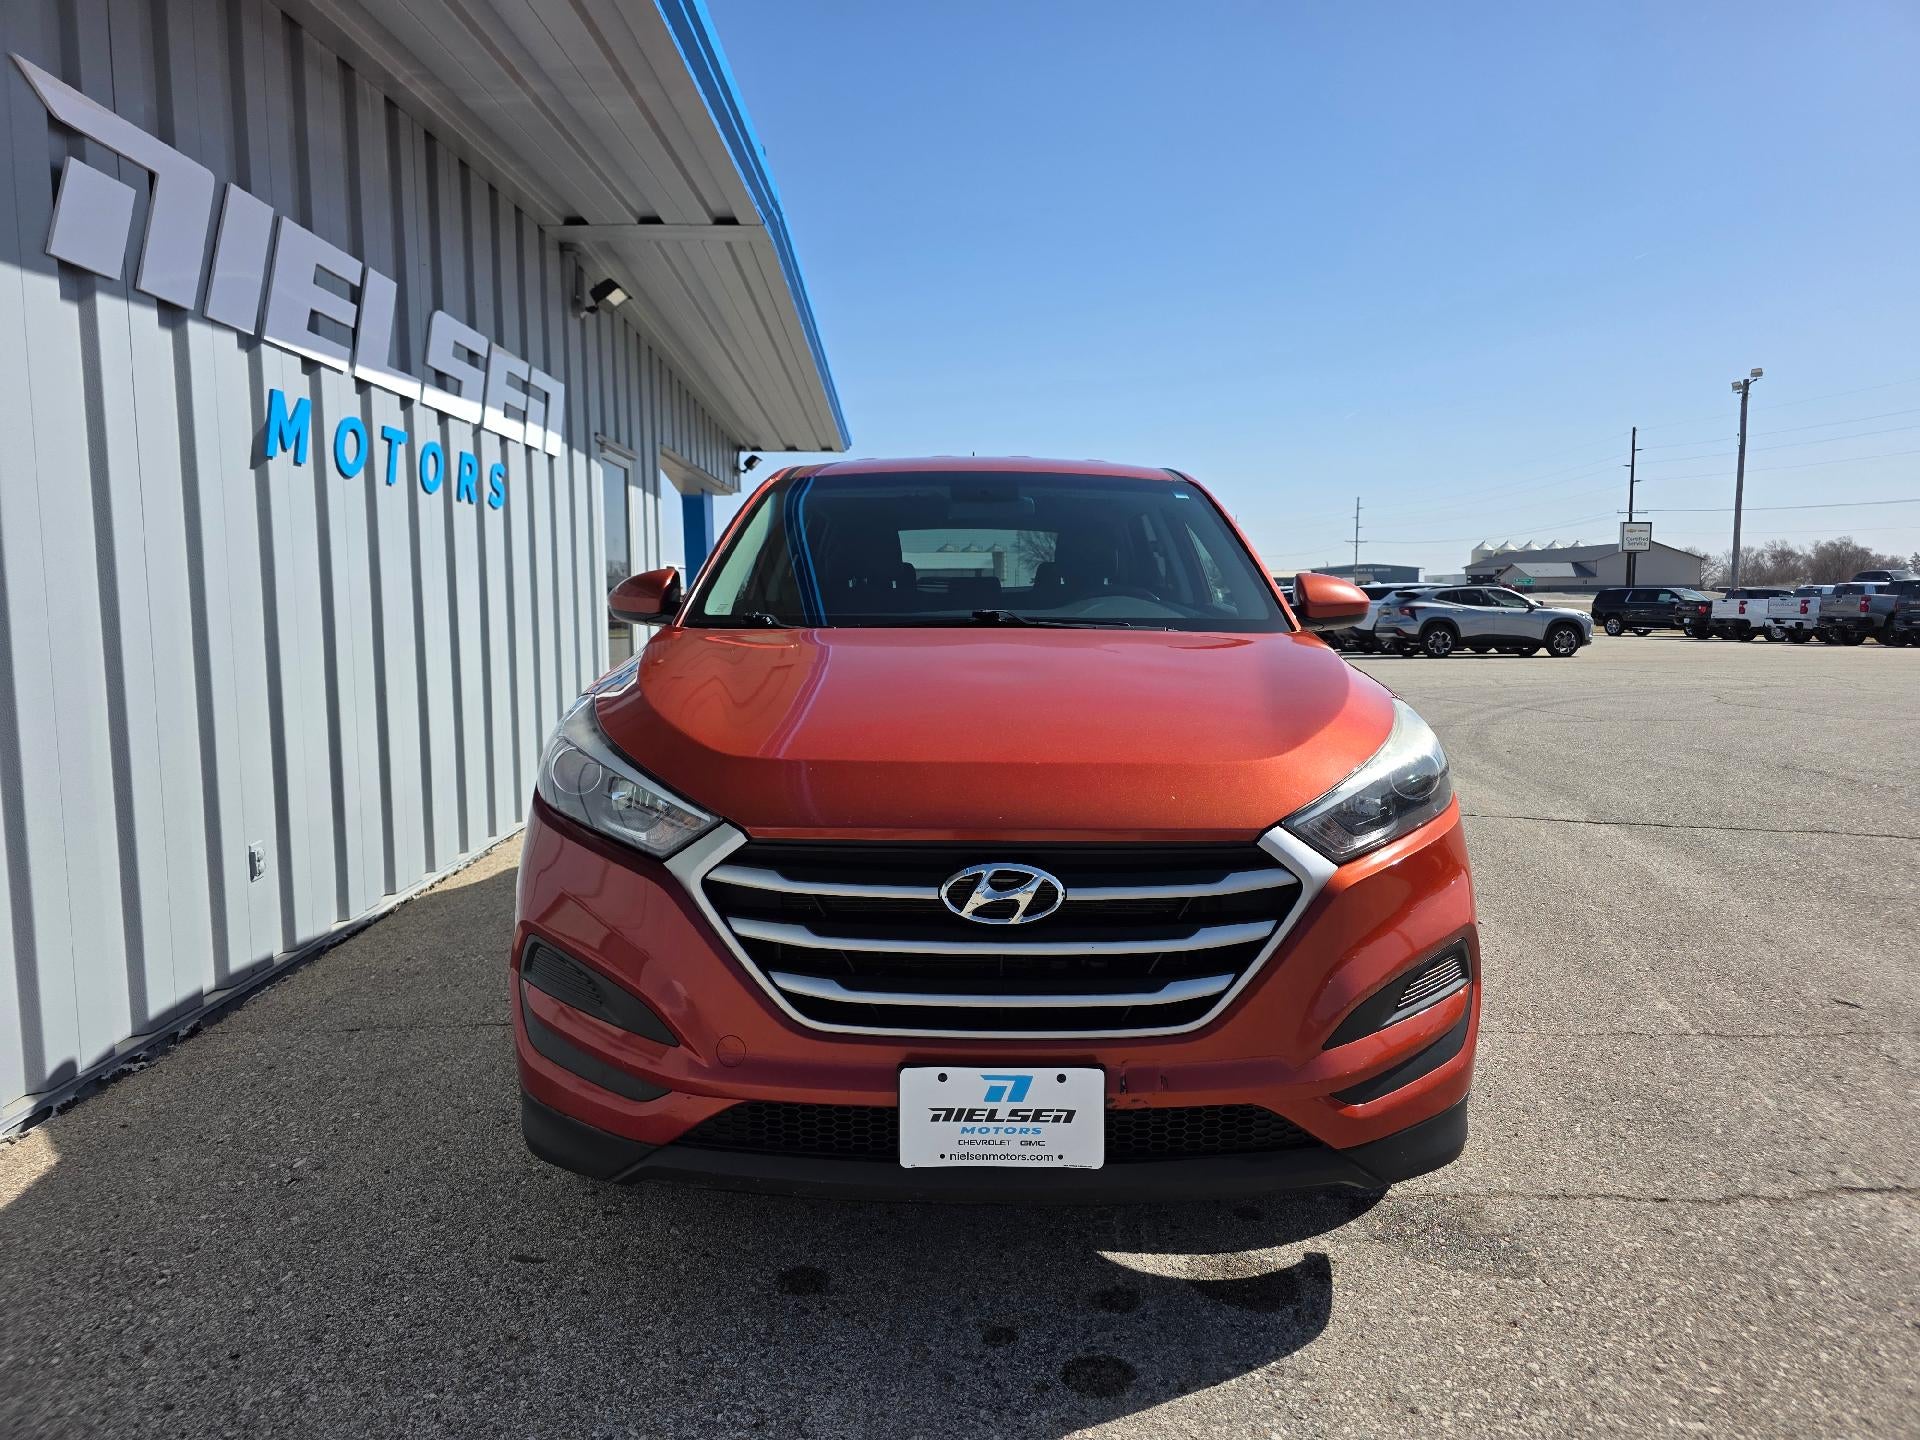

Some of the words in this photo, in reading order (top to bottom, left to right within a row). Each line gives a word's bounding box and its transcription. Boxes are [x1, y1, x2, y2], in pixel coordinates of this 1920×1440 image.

[266, 388, 507, 510] MOTORS
[960, 1126, 1042, 1135] MOTORS
[957, 1139, 1011, 1147] CHEVROLET
[949, 1151, 1054, 1162] nielsenmotors.com
